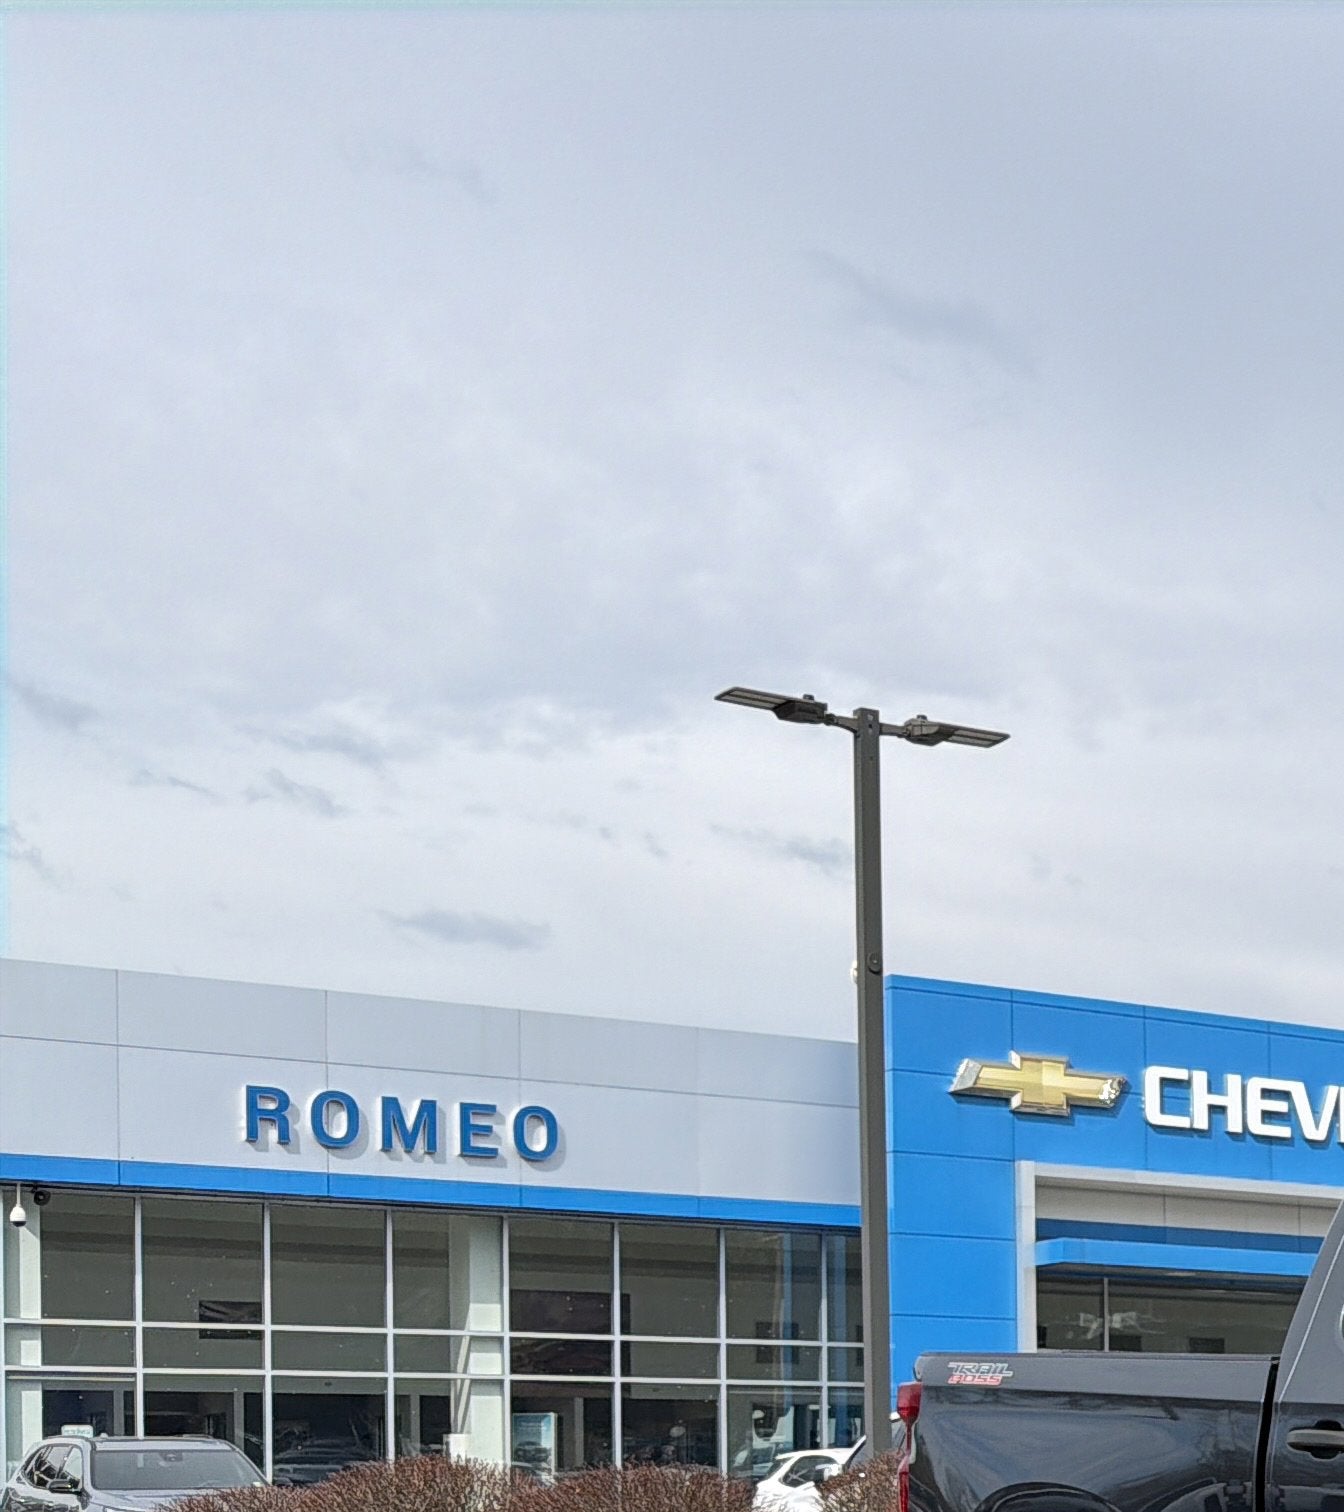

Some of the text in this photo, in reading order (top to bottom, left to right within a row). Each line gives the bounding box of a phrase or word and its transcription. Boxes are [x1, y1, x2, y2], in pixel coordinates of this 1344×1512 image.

[245, 1084, 558, 1161] ROMEO
[947, 1361, 1014, 1377] TRAIL
[947, 1374, 1003, 1386] BOSS
